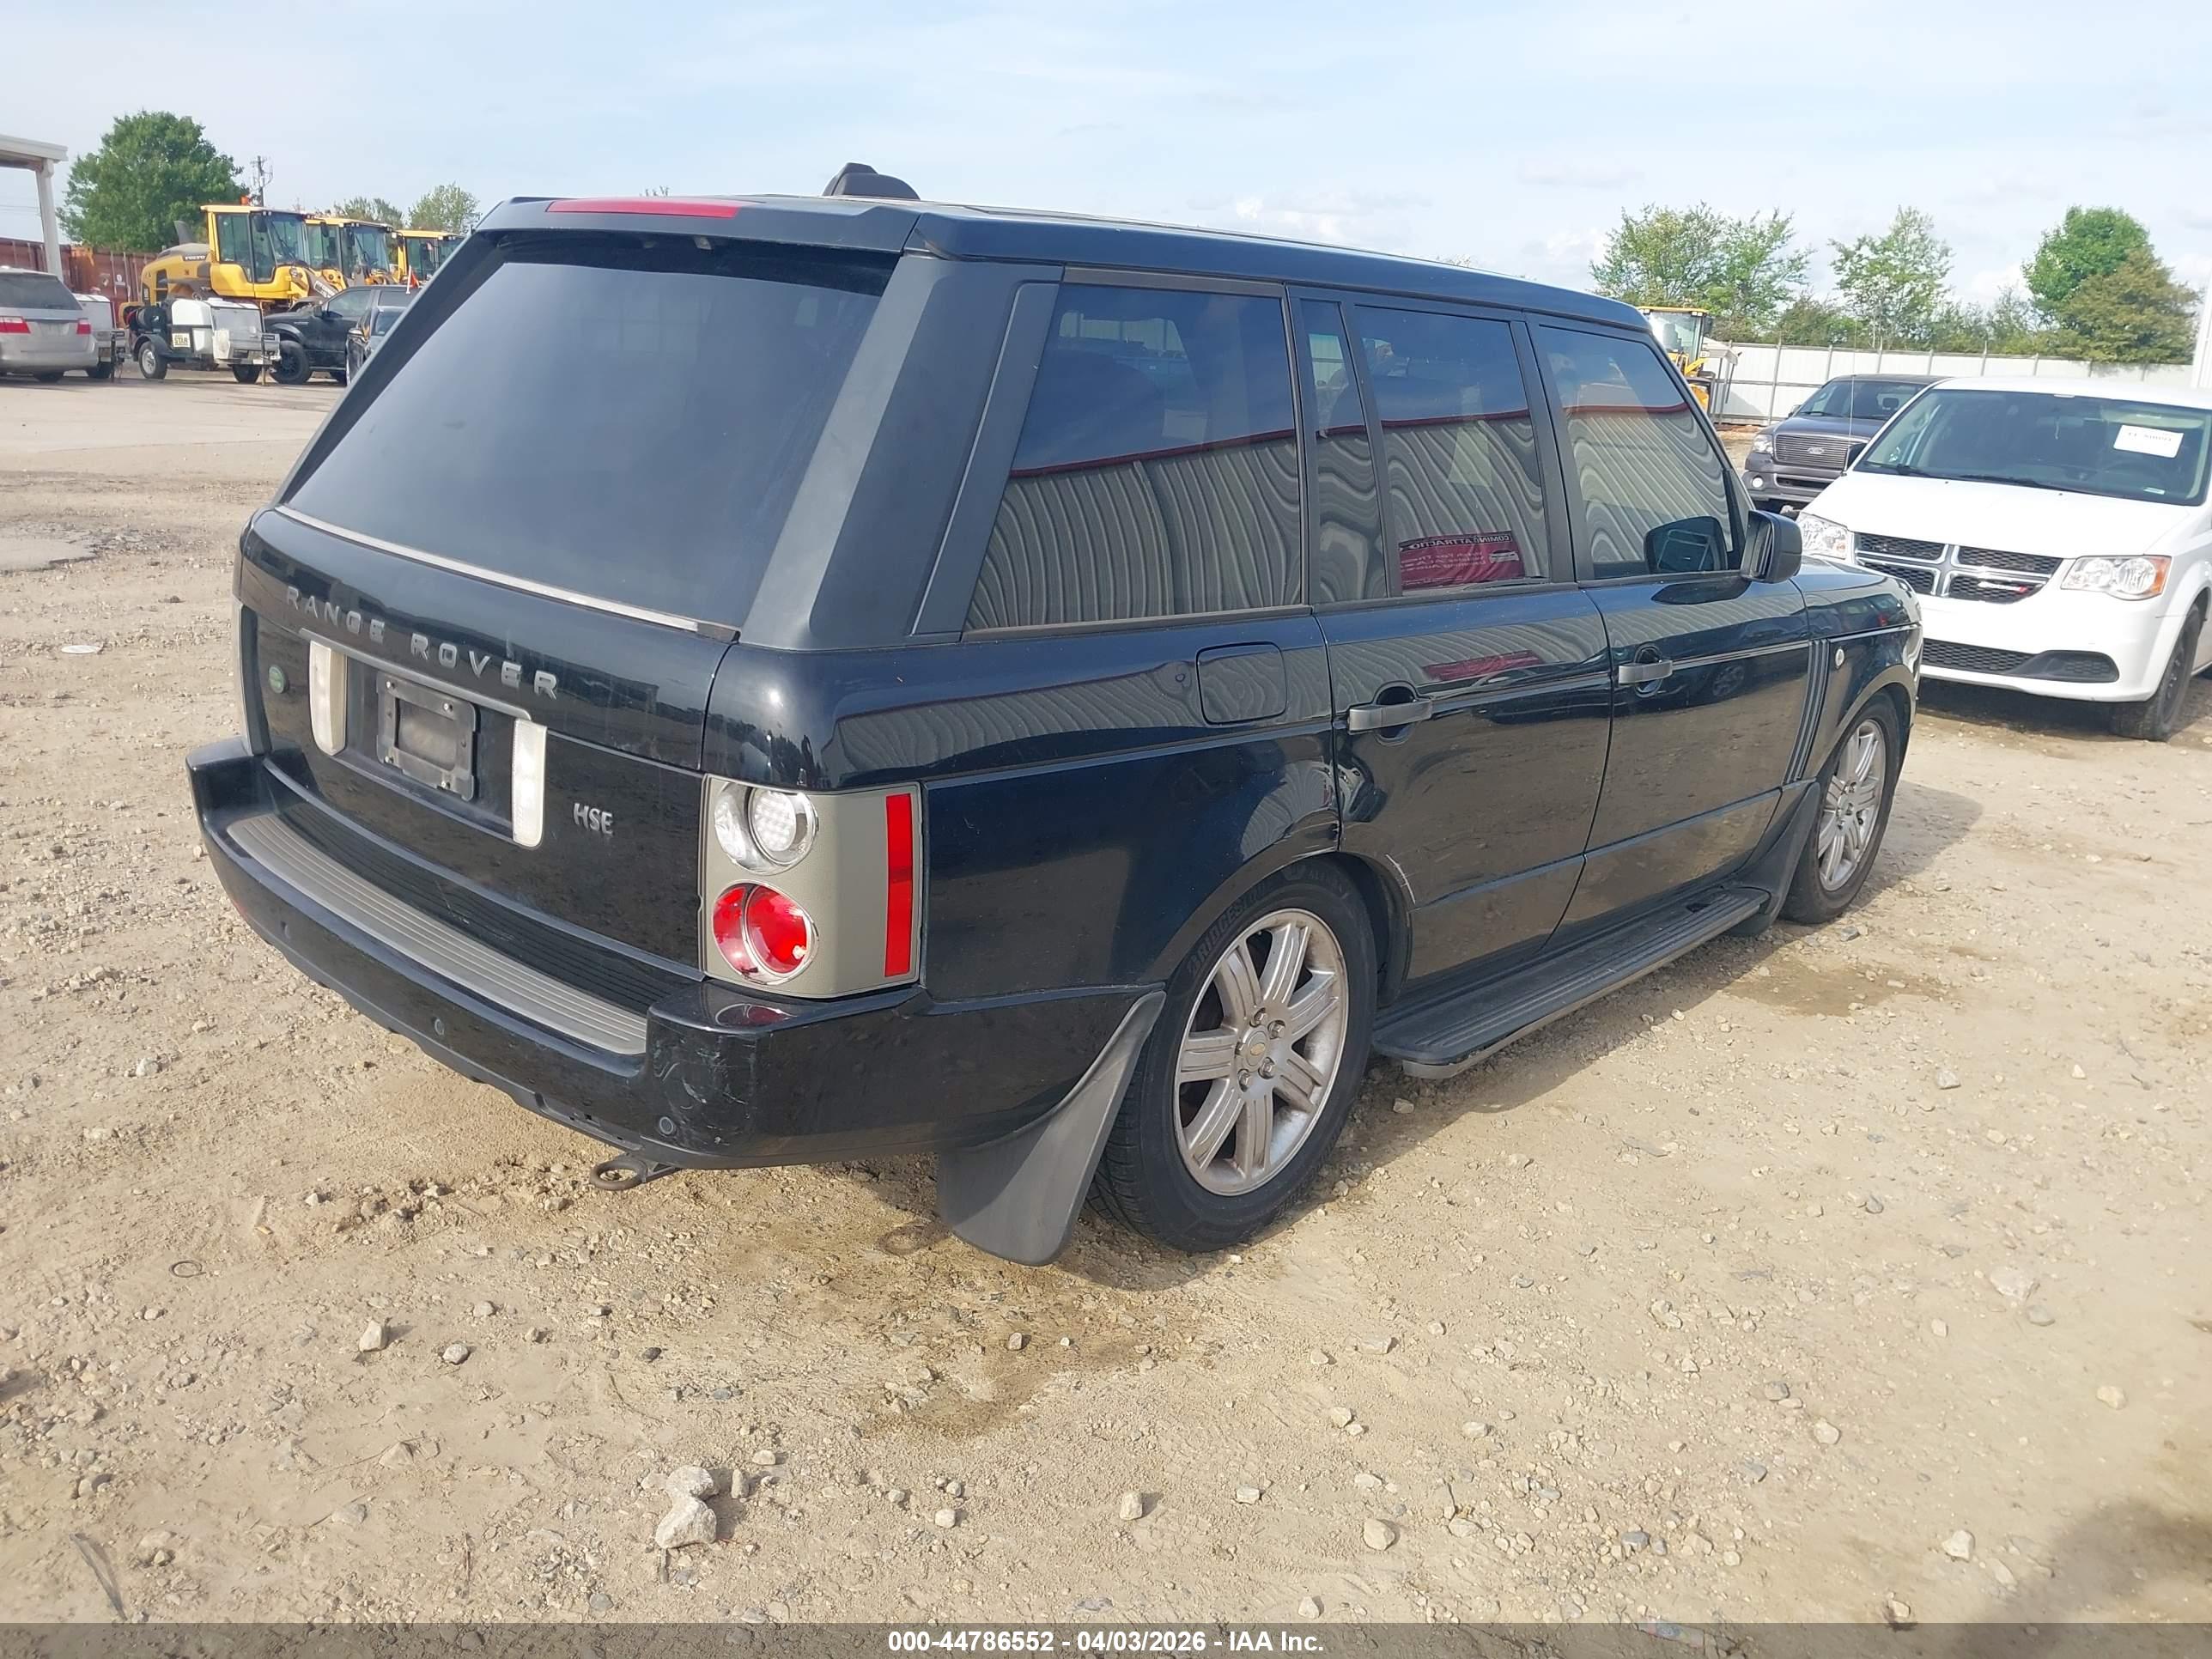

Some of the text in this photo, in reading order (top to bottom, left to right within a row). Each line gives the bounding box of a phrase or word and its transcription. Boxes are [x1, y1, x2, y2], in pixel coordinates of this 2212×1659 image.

[286, 586, 557, 701] RANGE ROVER
[573, 802, 613, 835] HSE
